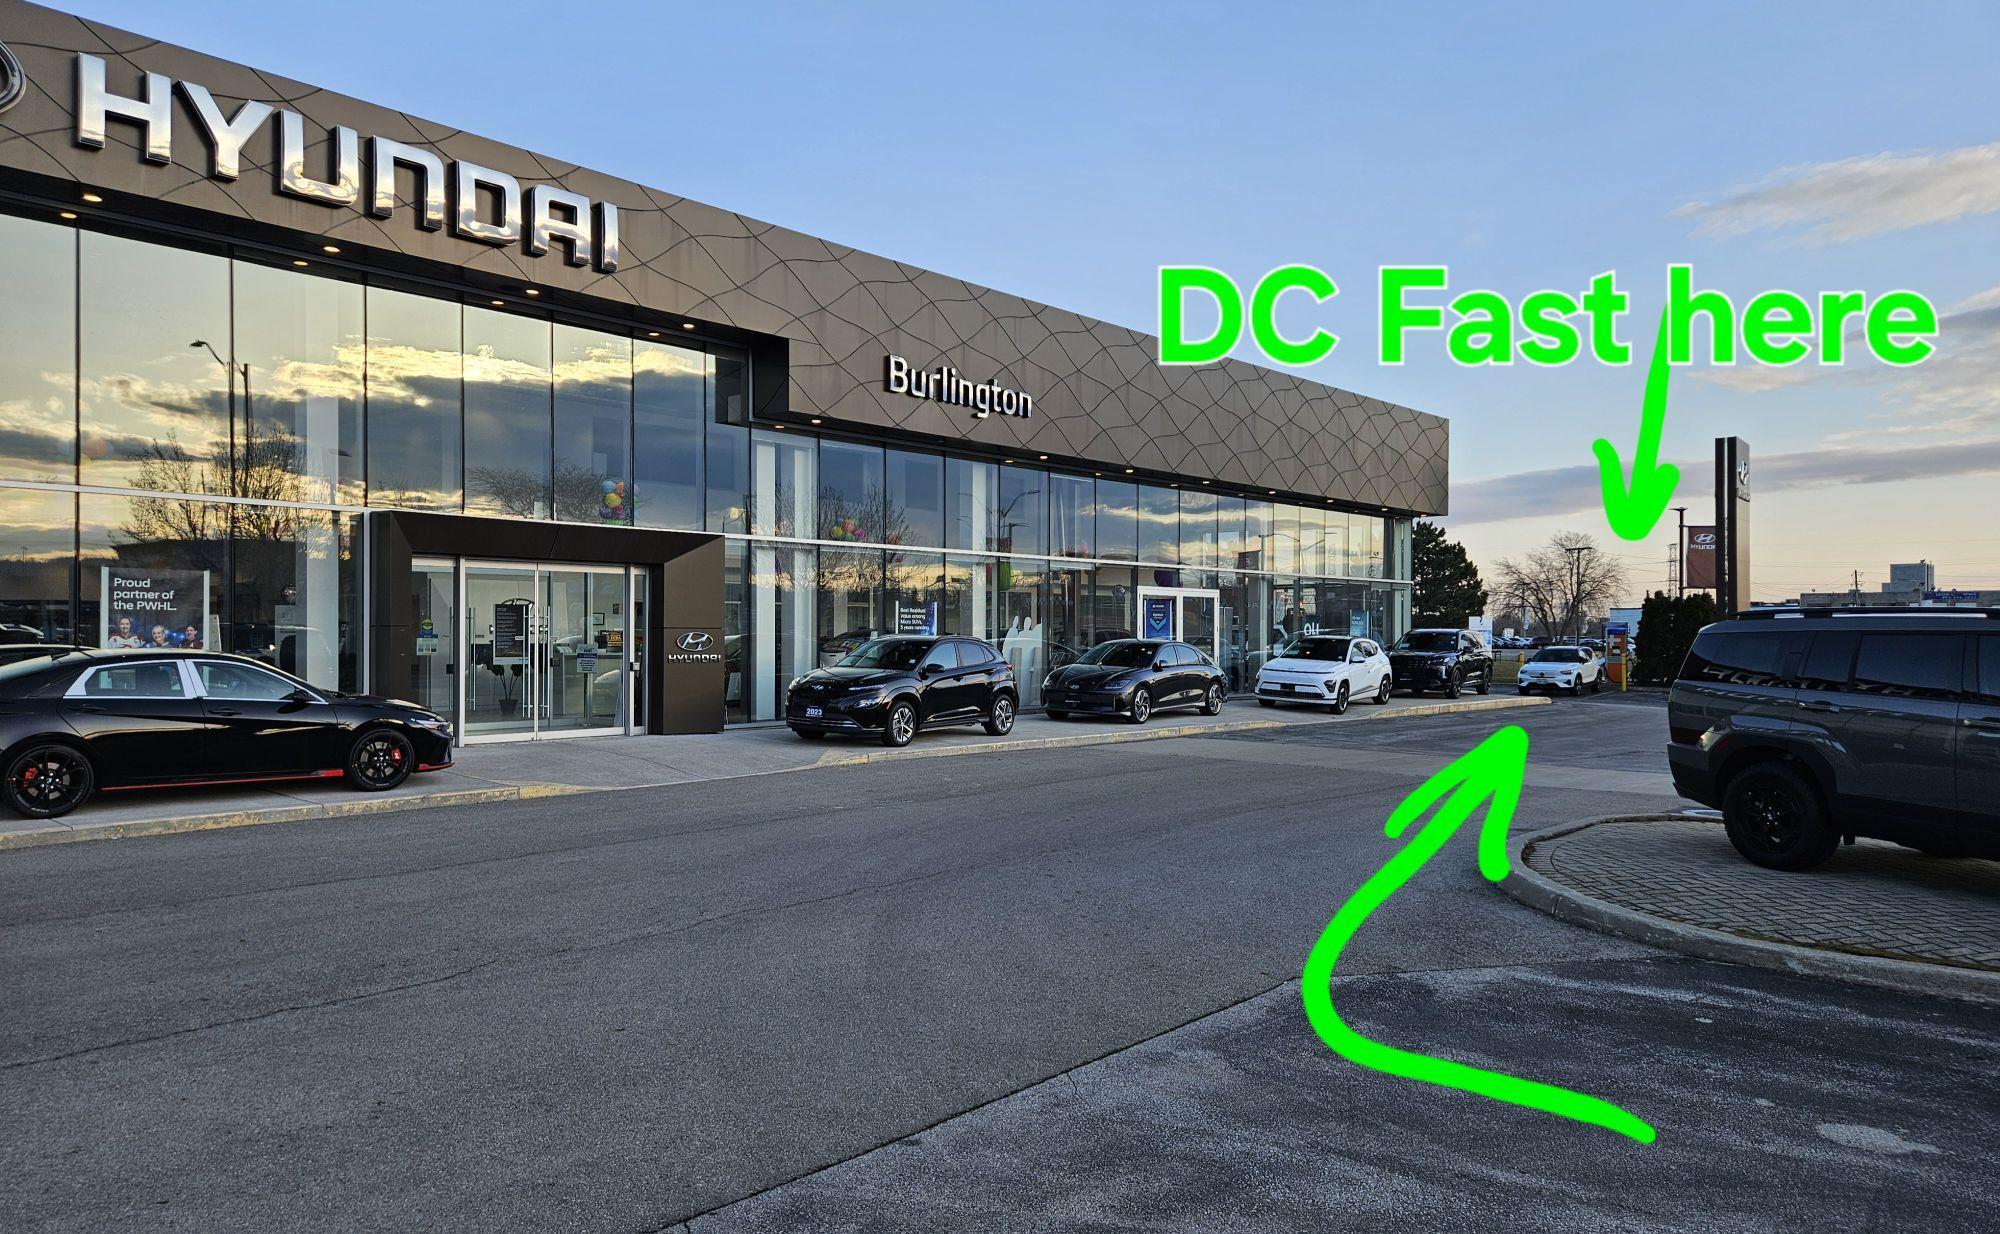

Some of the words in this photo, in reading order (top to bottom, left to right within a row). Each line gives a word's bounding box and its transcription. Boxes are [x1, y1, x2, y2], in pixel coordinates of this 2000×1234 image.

[77, 52, 619, 273] HYUNDAI
[889, 354, 1033, 419] Burlington
[113, 577, 151, 588] Proud
[113, 590, 160, 600] partner
[161, 590, 175, 600] of
[113, 601, 134, 610] the
[136, 601, 177, 611] PWHL.
[668, 654, 722, 663] HYUNDAI
[806, 707, 823, 716] 2023
